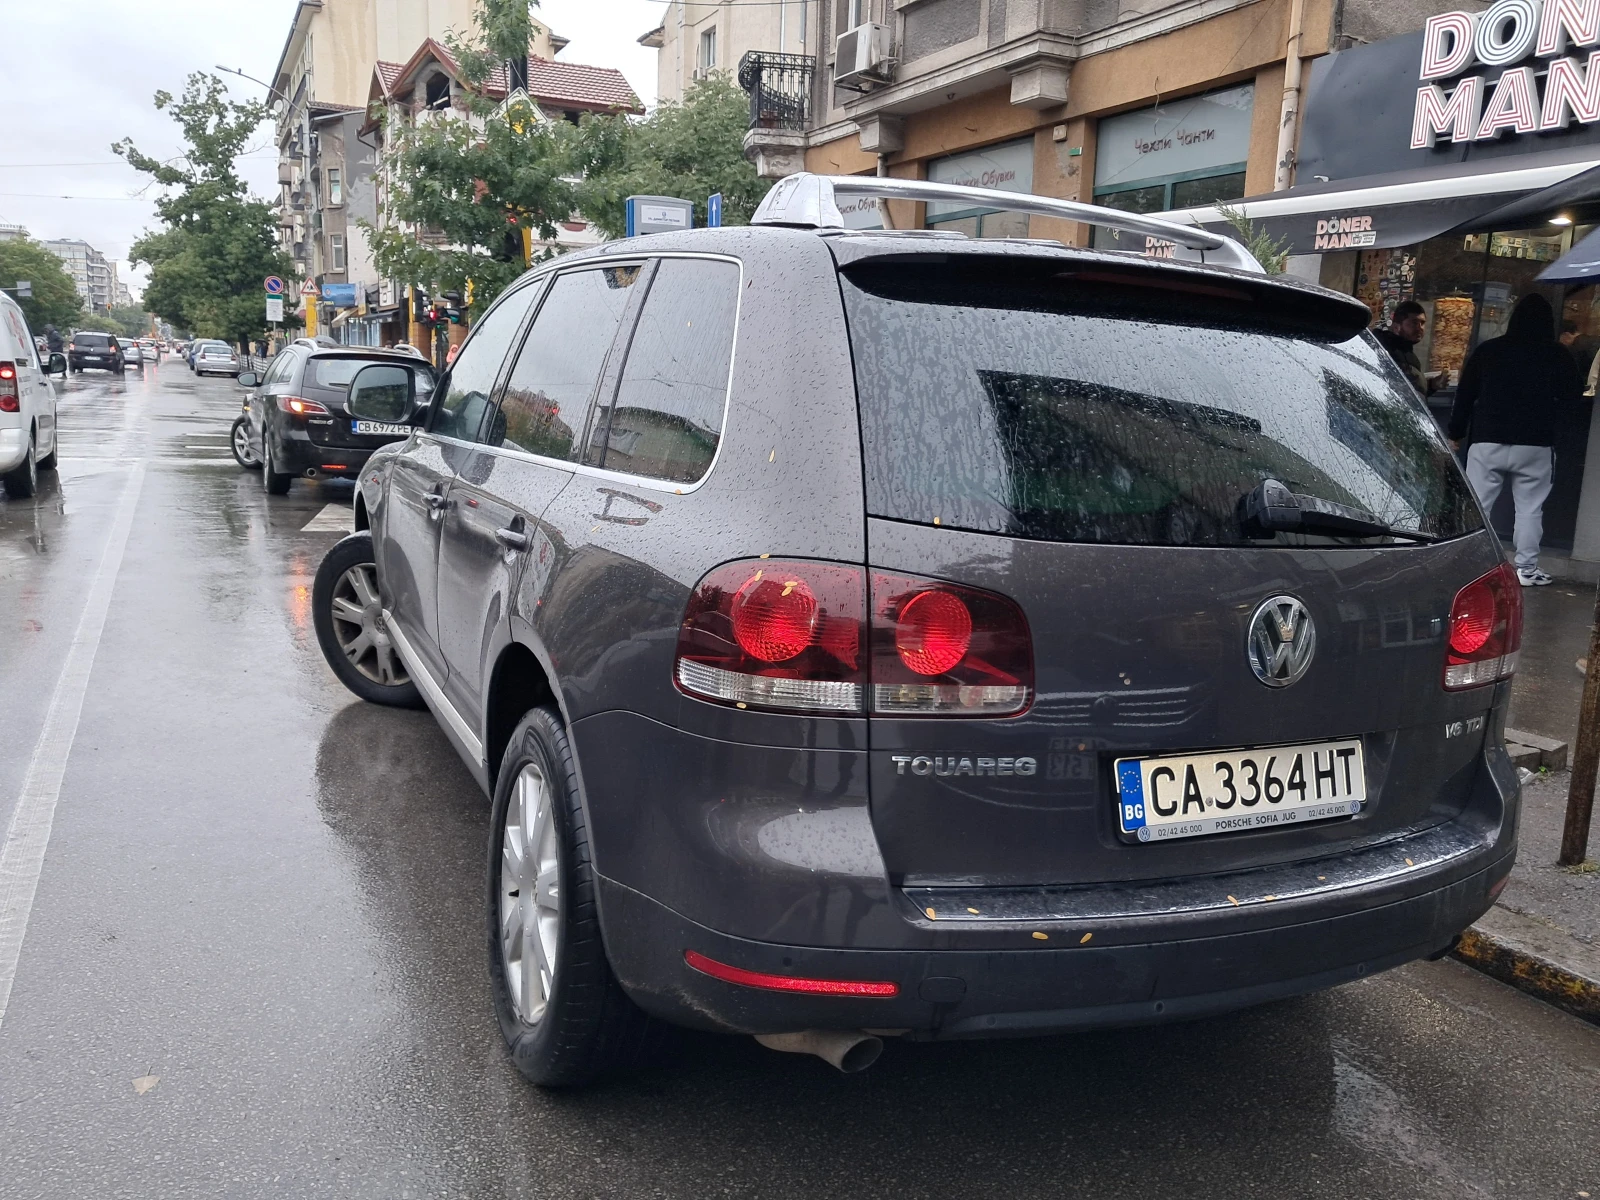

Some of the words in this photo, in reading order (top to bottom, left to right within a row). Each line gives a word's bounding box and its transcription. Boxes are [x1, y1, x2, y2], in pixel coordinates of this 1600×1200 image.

[1410, 51, 1600, 149] MAN
[1134, 138, 1172, 154] Чехли
[1177, 129, 1215, 146] Чанти
[981, 169, 1016, 188] Обувки
[1316, 216, 1373, 235] DÖNER
[1314, 232, 1353, 250] MAN
[358, 422, 371, 432] CB
[1445, 721, 1463, 739] V6
[891, 755, 1037, 777] TOUAREG
[1150, 764, 1205, 817] CA
[1214, 753, 1307, 810] 3364
[1311, 748, 1356, 800] HT
[1125, 804, 1143, 820] BG
[1157, 826, 1179, 837] 02/42
[1180, 825, 1188, 834] 45
[1190, 824, 1203, 833] 000
[1215, 817, 1252, 830] PORSCHE
[1256, 814, 1279, 825] SOFIA
[1282, 811, 1297, 822] JUG
[1308, 807, 1325, 818] 02/42
[1327, 806, 1334, 815] 45
[1335, 805, 1346, 814] 000
